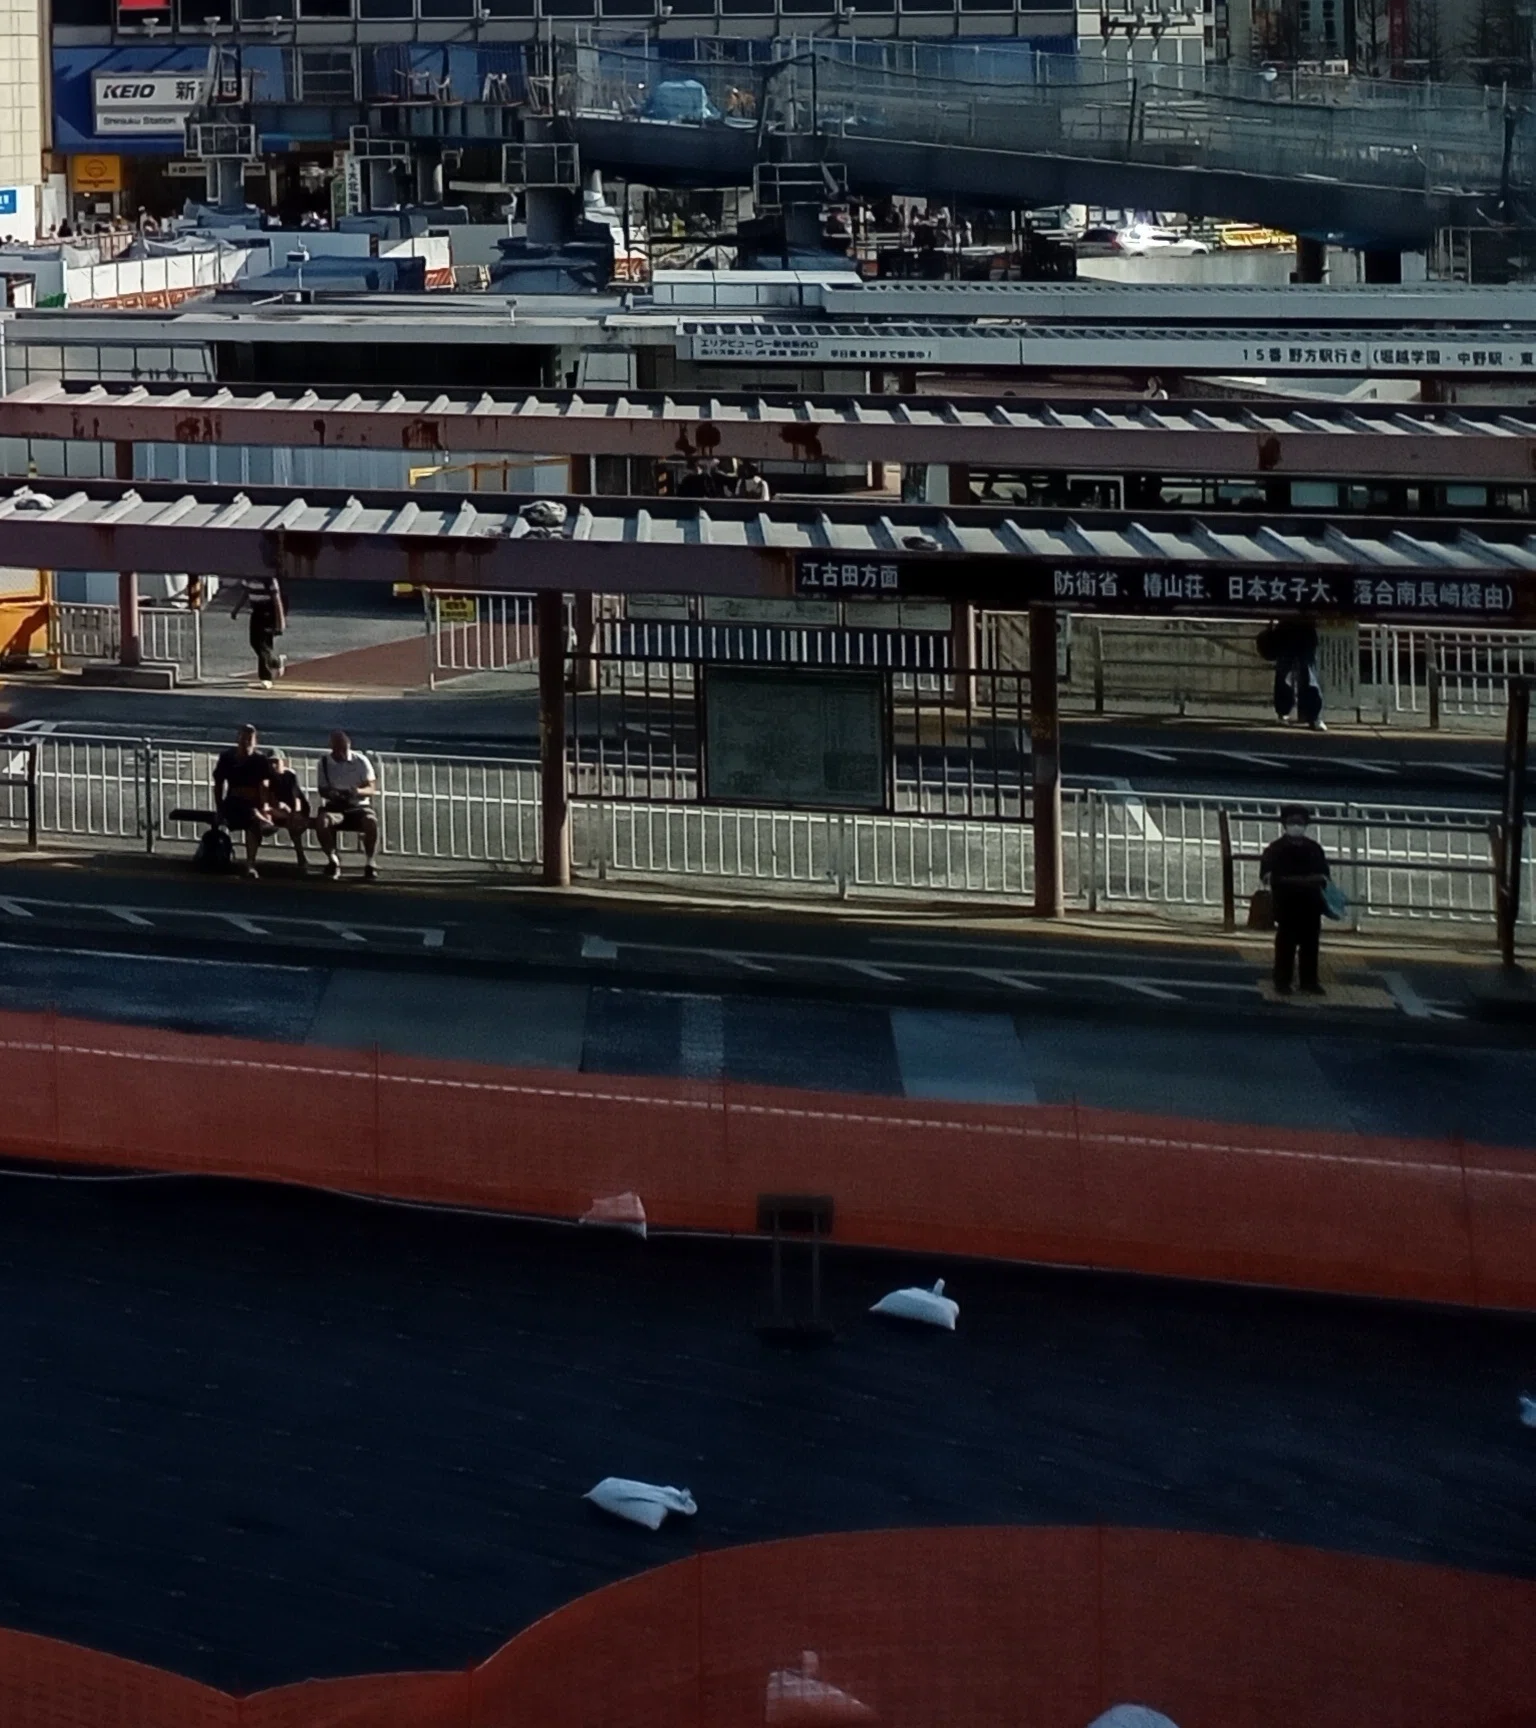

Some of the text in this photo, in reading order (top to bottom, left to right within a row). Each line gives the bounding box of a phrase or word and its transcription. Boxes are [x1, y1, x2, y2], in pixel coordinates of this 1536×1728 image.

[103, 84, 156, 99] KEIO
[801, 561, 899, 589] 江古田方面
